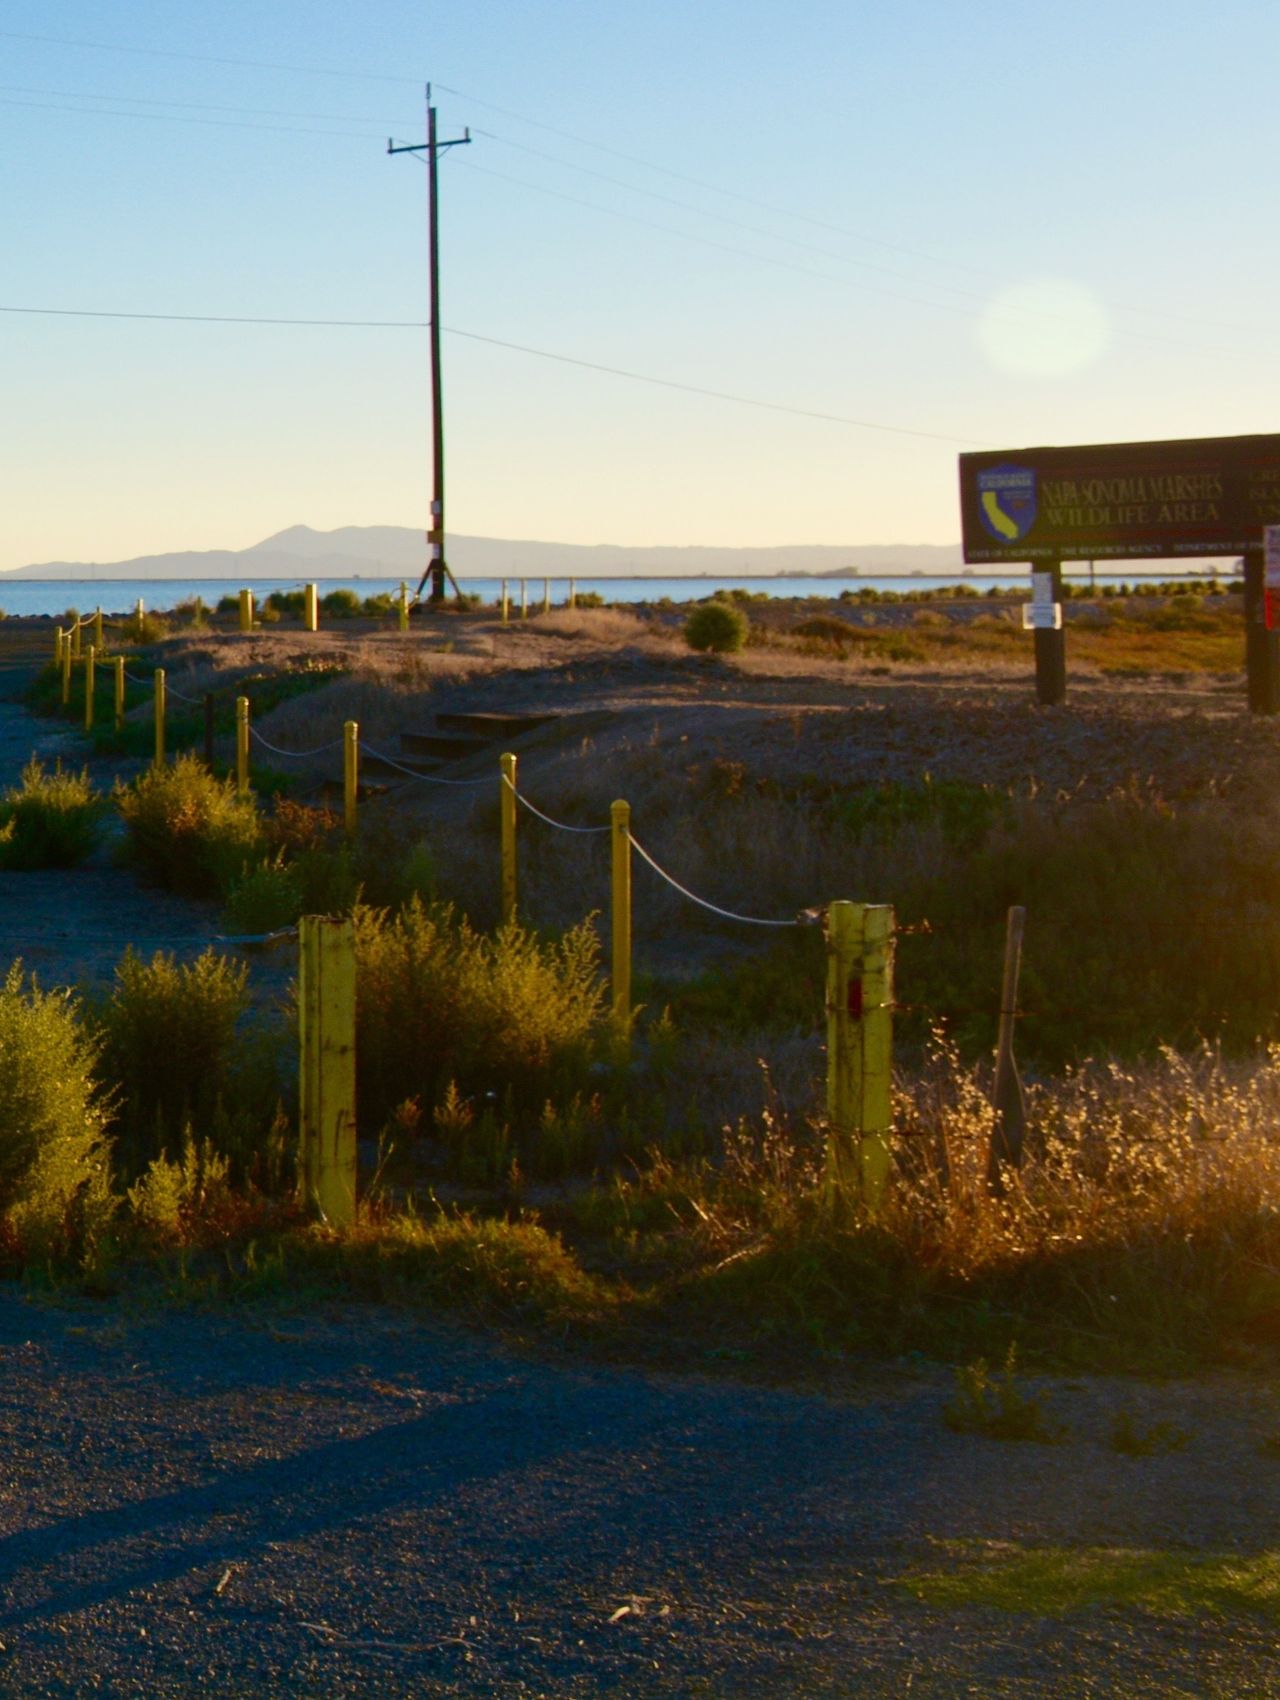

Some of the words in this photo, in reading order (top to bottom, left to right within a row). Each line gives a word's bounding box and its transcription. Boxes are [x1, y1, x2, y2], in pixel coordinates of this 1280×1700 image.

[1149, 472, 1224, 501] MARSHES
[1045, 503, 1151, 527] WILDLIFE
[1156, 502, 1221, 523] AREA
